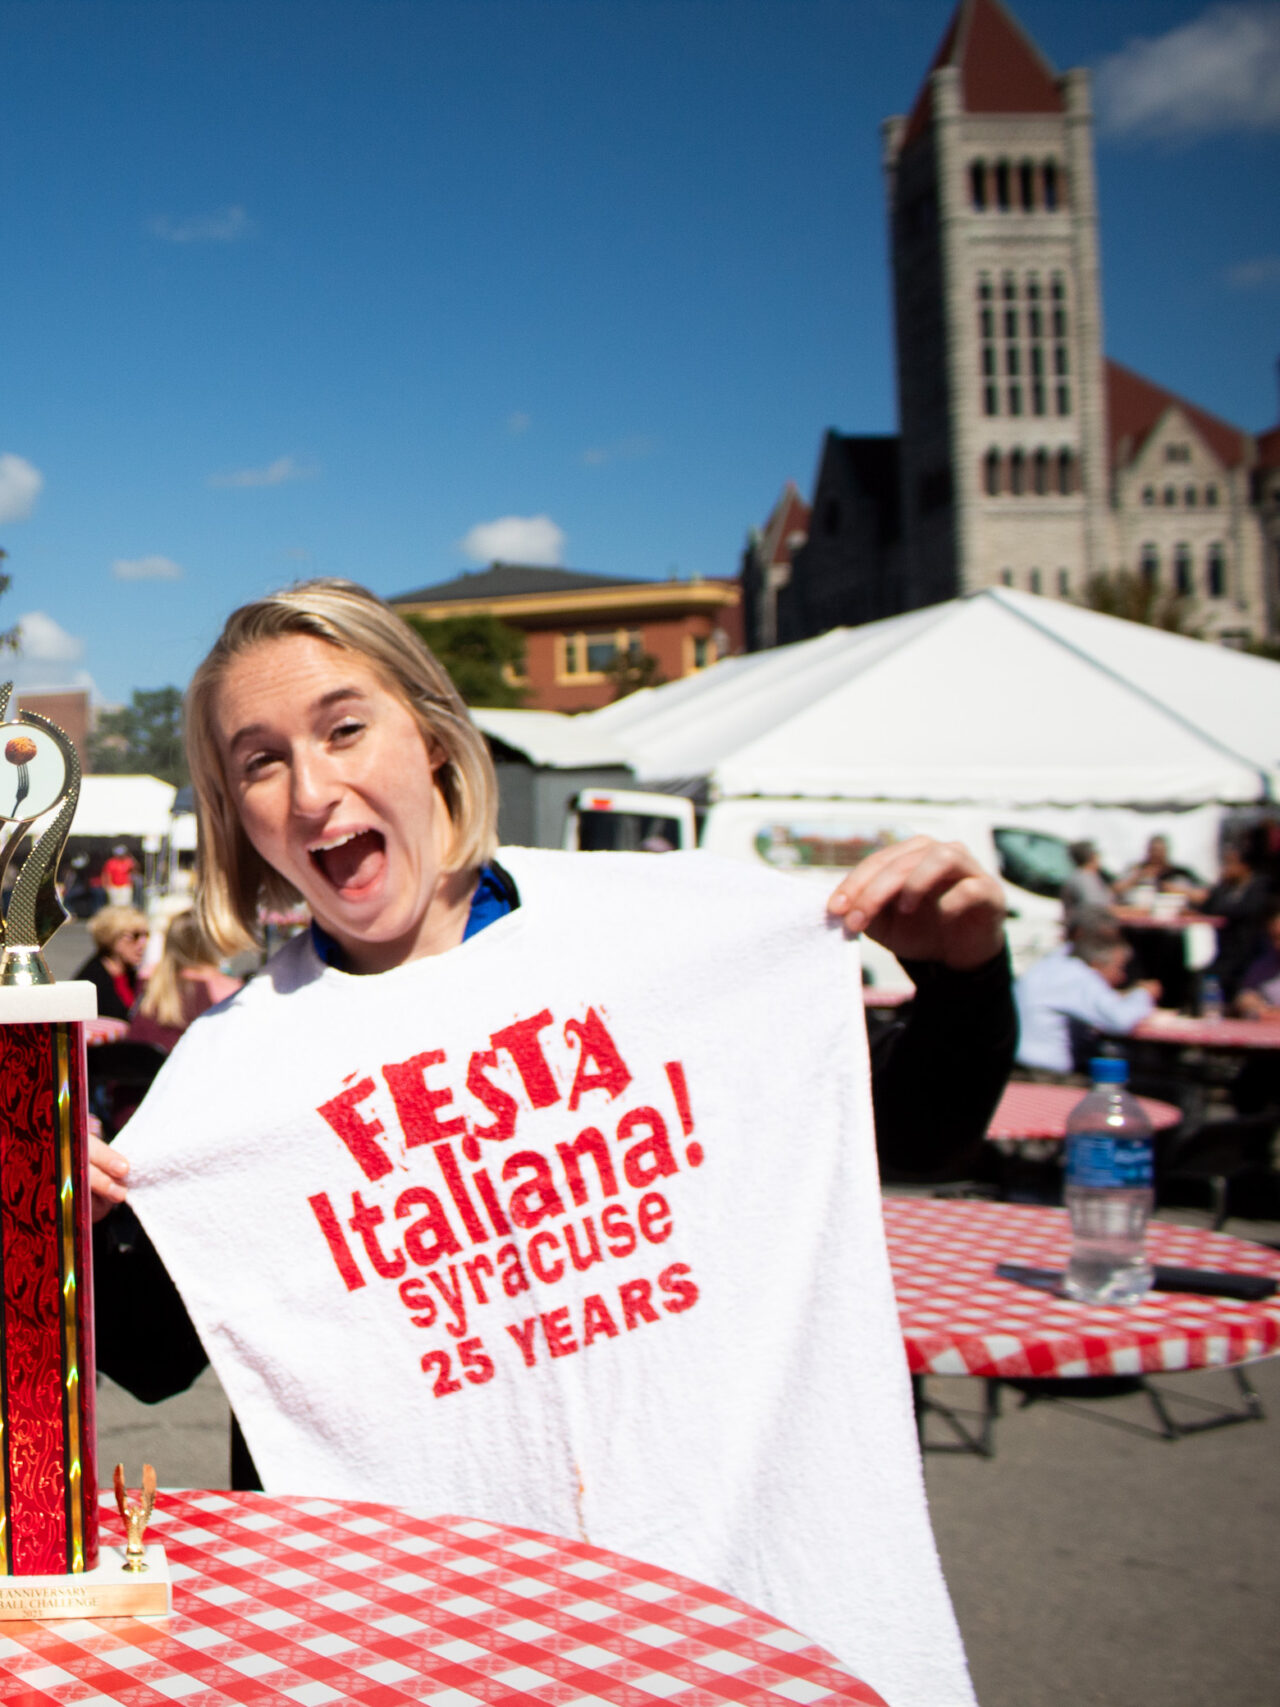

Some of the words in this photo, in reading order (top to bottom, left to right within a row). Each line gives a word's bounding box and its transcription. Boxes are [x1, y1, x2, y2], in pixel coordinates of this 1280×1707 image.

[315, 1005, 633, 1182] FESTA
[307, 1061, 705, 1292] Italiana!
[398, 1191, 673, 1338] syracuse
[420, 1337, 495, 1398] 25
[505, 1262, 700, 1367] YEARS
[6, 1587, 88, 1599] ANNIVERSARY
[29, 1597, 98, 1609] CHALLENGE
